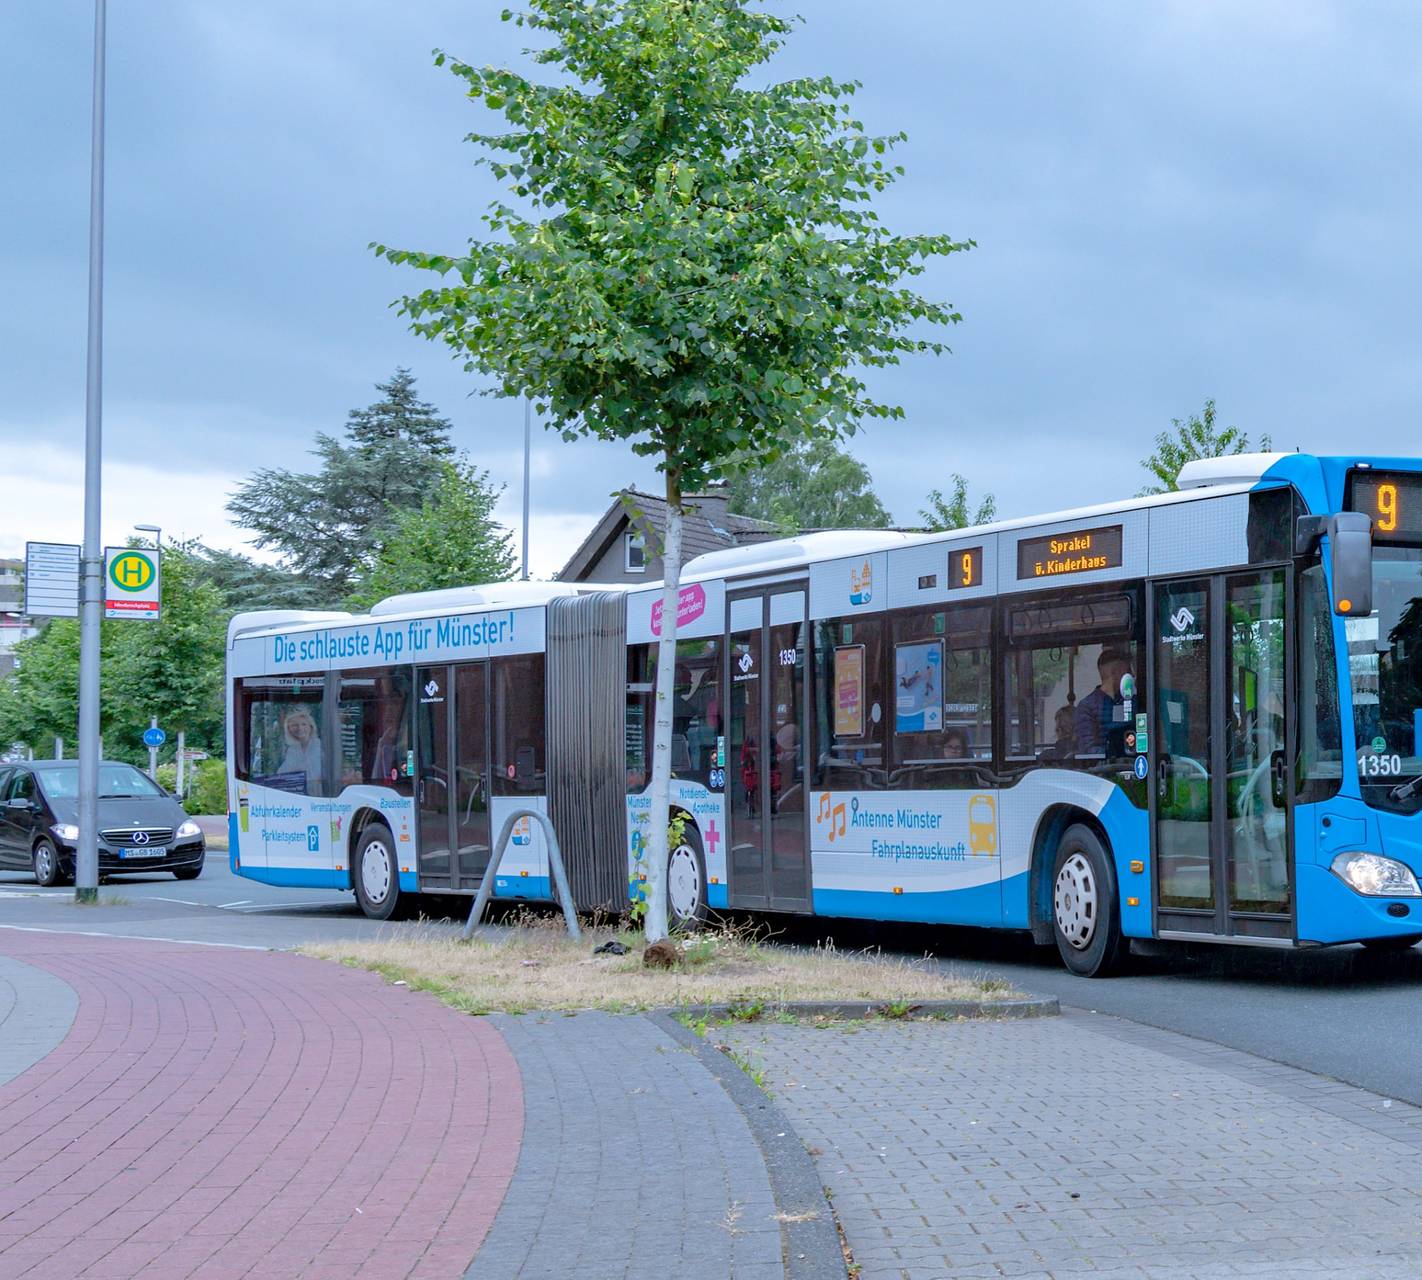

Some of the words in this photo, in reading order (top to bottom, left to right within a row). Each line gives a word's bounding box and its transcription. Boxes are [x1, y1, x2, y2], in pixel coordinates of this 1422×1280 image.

[1377, 484, 1399, 531] 9
[1050, 535, 1092, 555] Sprakel
[962, 553, 973, 586] 9
[1047, 555, 1107, 574] Kinderhaus
[274, 635, 296, 664] Die
[299, 631, 369, 660] schlauste
[373, 626, 403, 661] App
[408, 621, 431, 651] für
[436, 611, 515, 649] Münster!
[779, 648, 796, 666] 1350
[1358, 754, 1401, 776] 1350
[250, 805, 302, 818] Abfuhrkalender
[379, 797, 411, 810] Baustellen
[627, 796, 652, 809] Münster
[692, 801, 720, 814] Apotheke
[851, 808, 894, 828] Antenne
[896, 809, 942, 829] Münster
[261, 830, 306, 844] Parkleitsystem
[871, 839, 966, 863] Fahrplanauskunft
